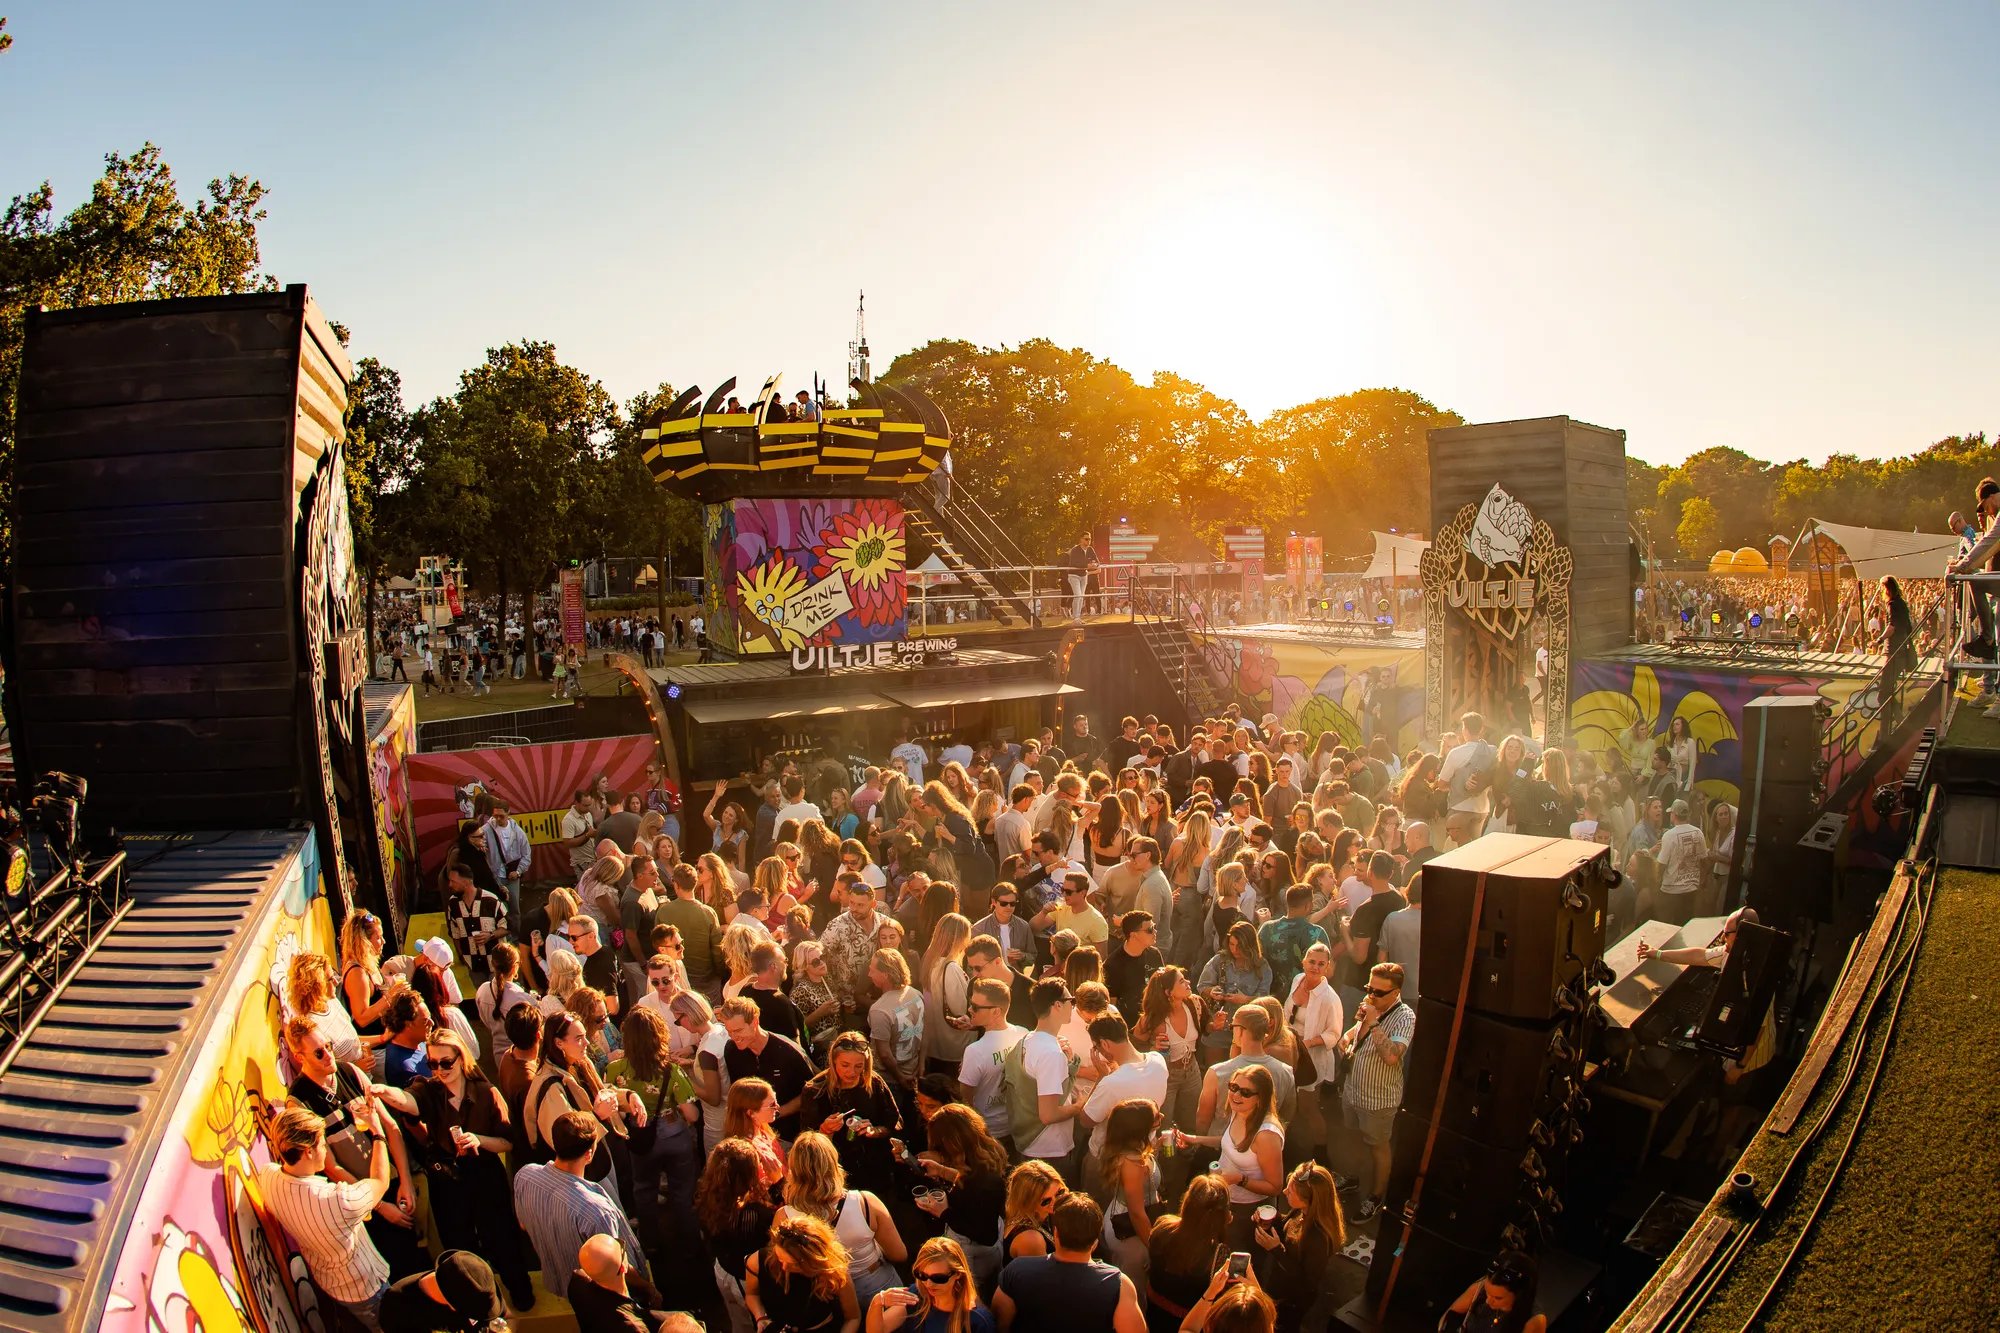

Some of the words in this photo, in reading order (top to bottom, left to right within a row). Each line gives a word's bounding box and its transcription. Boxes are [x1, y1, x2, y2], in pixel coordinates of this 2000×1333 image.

[789, 581, 842, 618] DRINK
[1448, 579, 1535, 608] UILTJE
[805, 603, 837, 628] ME
[792, 642, 894, 671] UILTJE
[897, 638, 957, 653] BREWING
